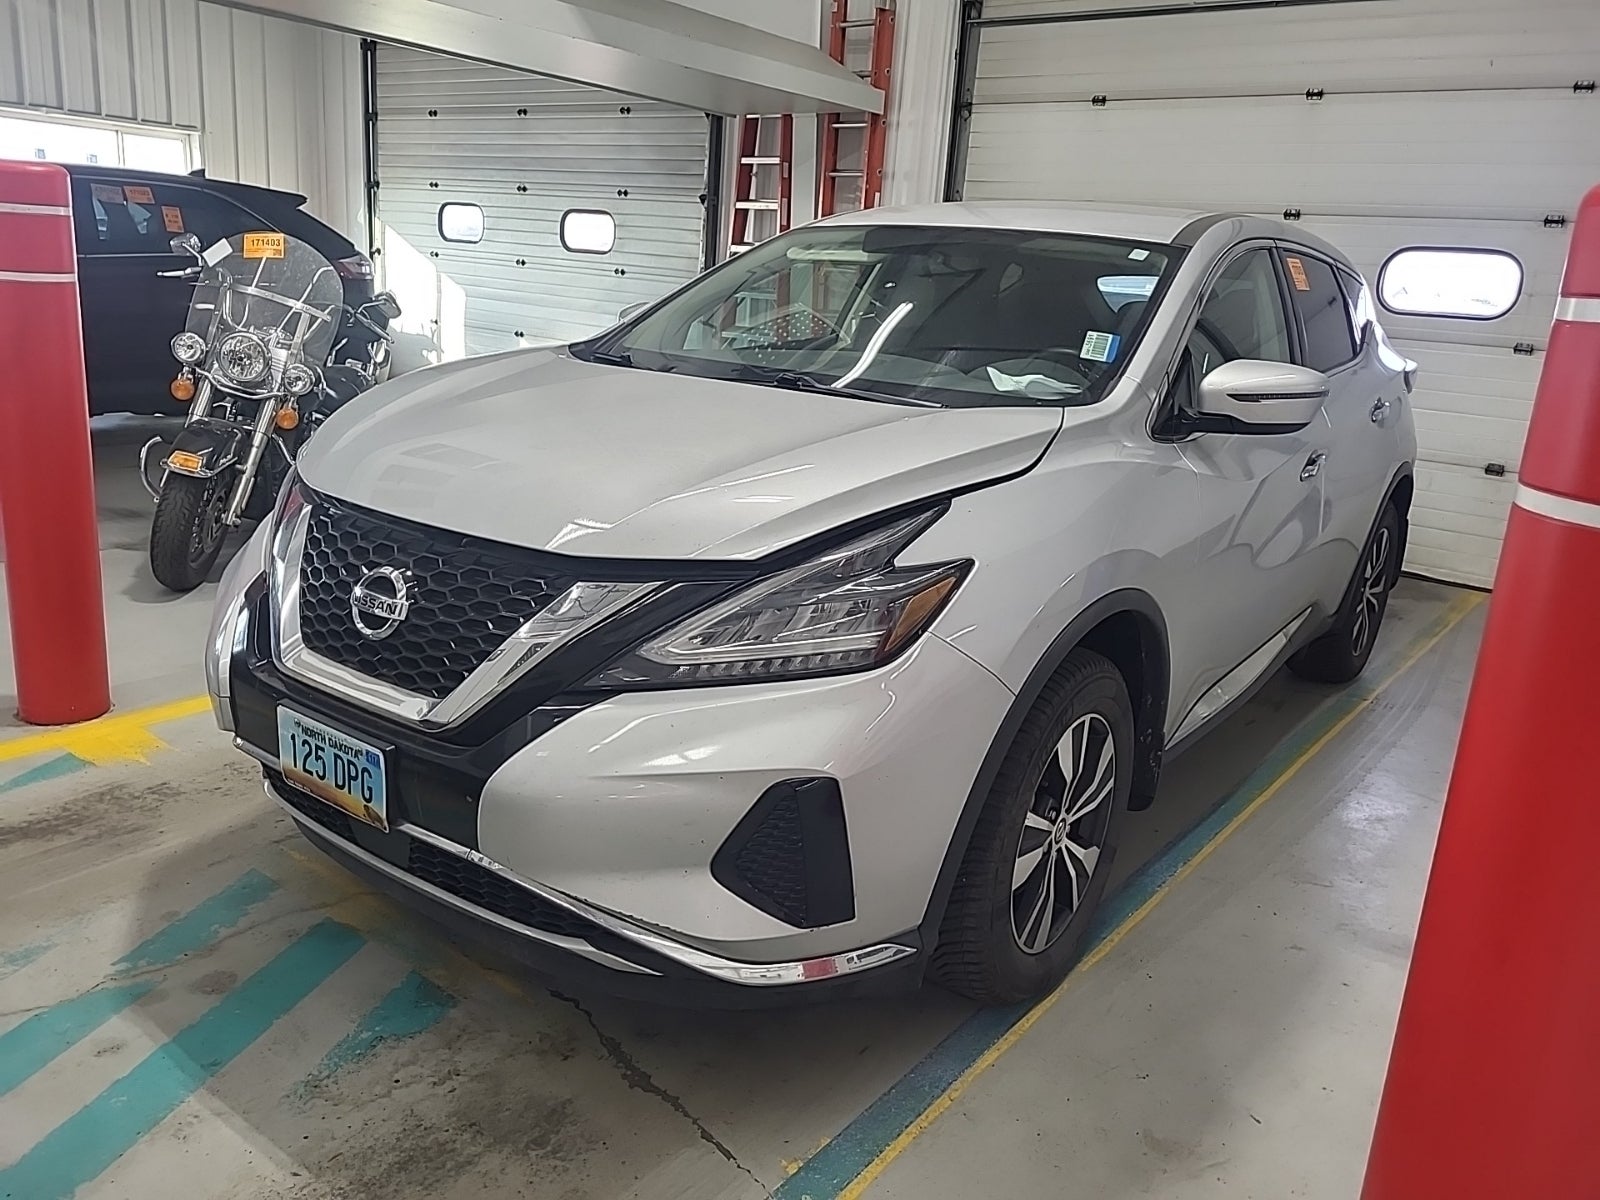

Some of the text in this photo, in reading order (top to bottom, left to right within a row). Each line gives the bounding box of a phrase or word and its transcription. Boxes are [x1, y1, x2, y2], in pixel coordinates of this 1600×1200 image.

[251, 238, 281, 247] 171403
[301, 724, 327, 746] NORTH
[328, 736, 361, 761] DAKOTA
[290, 733, 373, 804] 125 DPG
